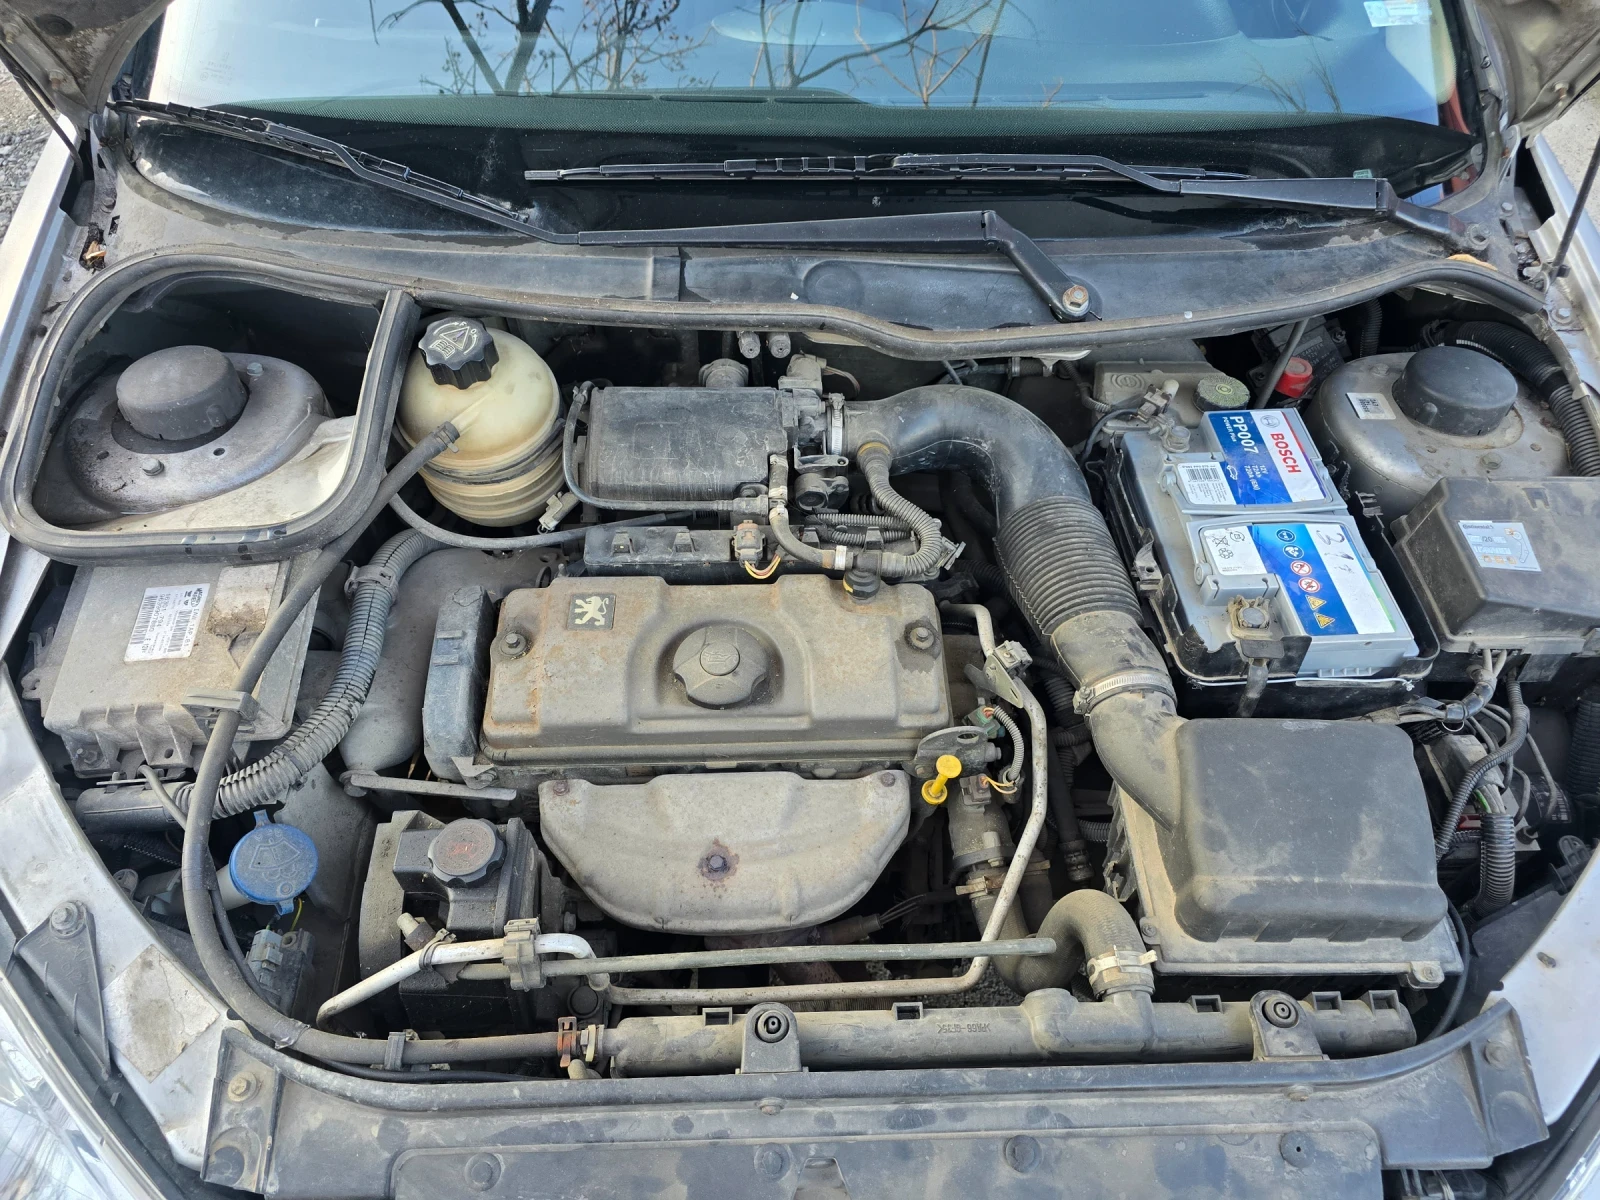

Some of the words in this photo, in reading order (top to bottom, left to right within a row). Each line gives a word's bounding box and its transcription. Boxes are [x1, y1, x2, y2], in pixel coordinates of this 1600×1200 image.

[1222, 416, 1233, 432] POWER
[1229, 416, 1259, 454] PP007
[1270, 433, 1302, 473] BOSCH
[1252, 465, 1262, 478] 72Ah
[1260, 465, 1268, 475] 12V
